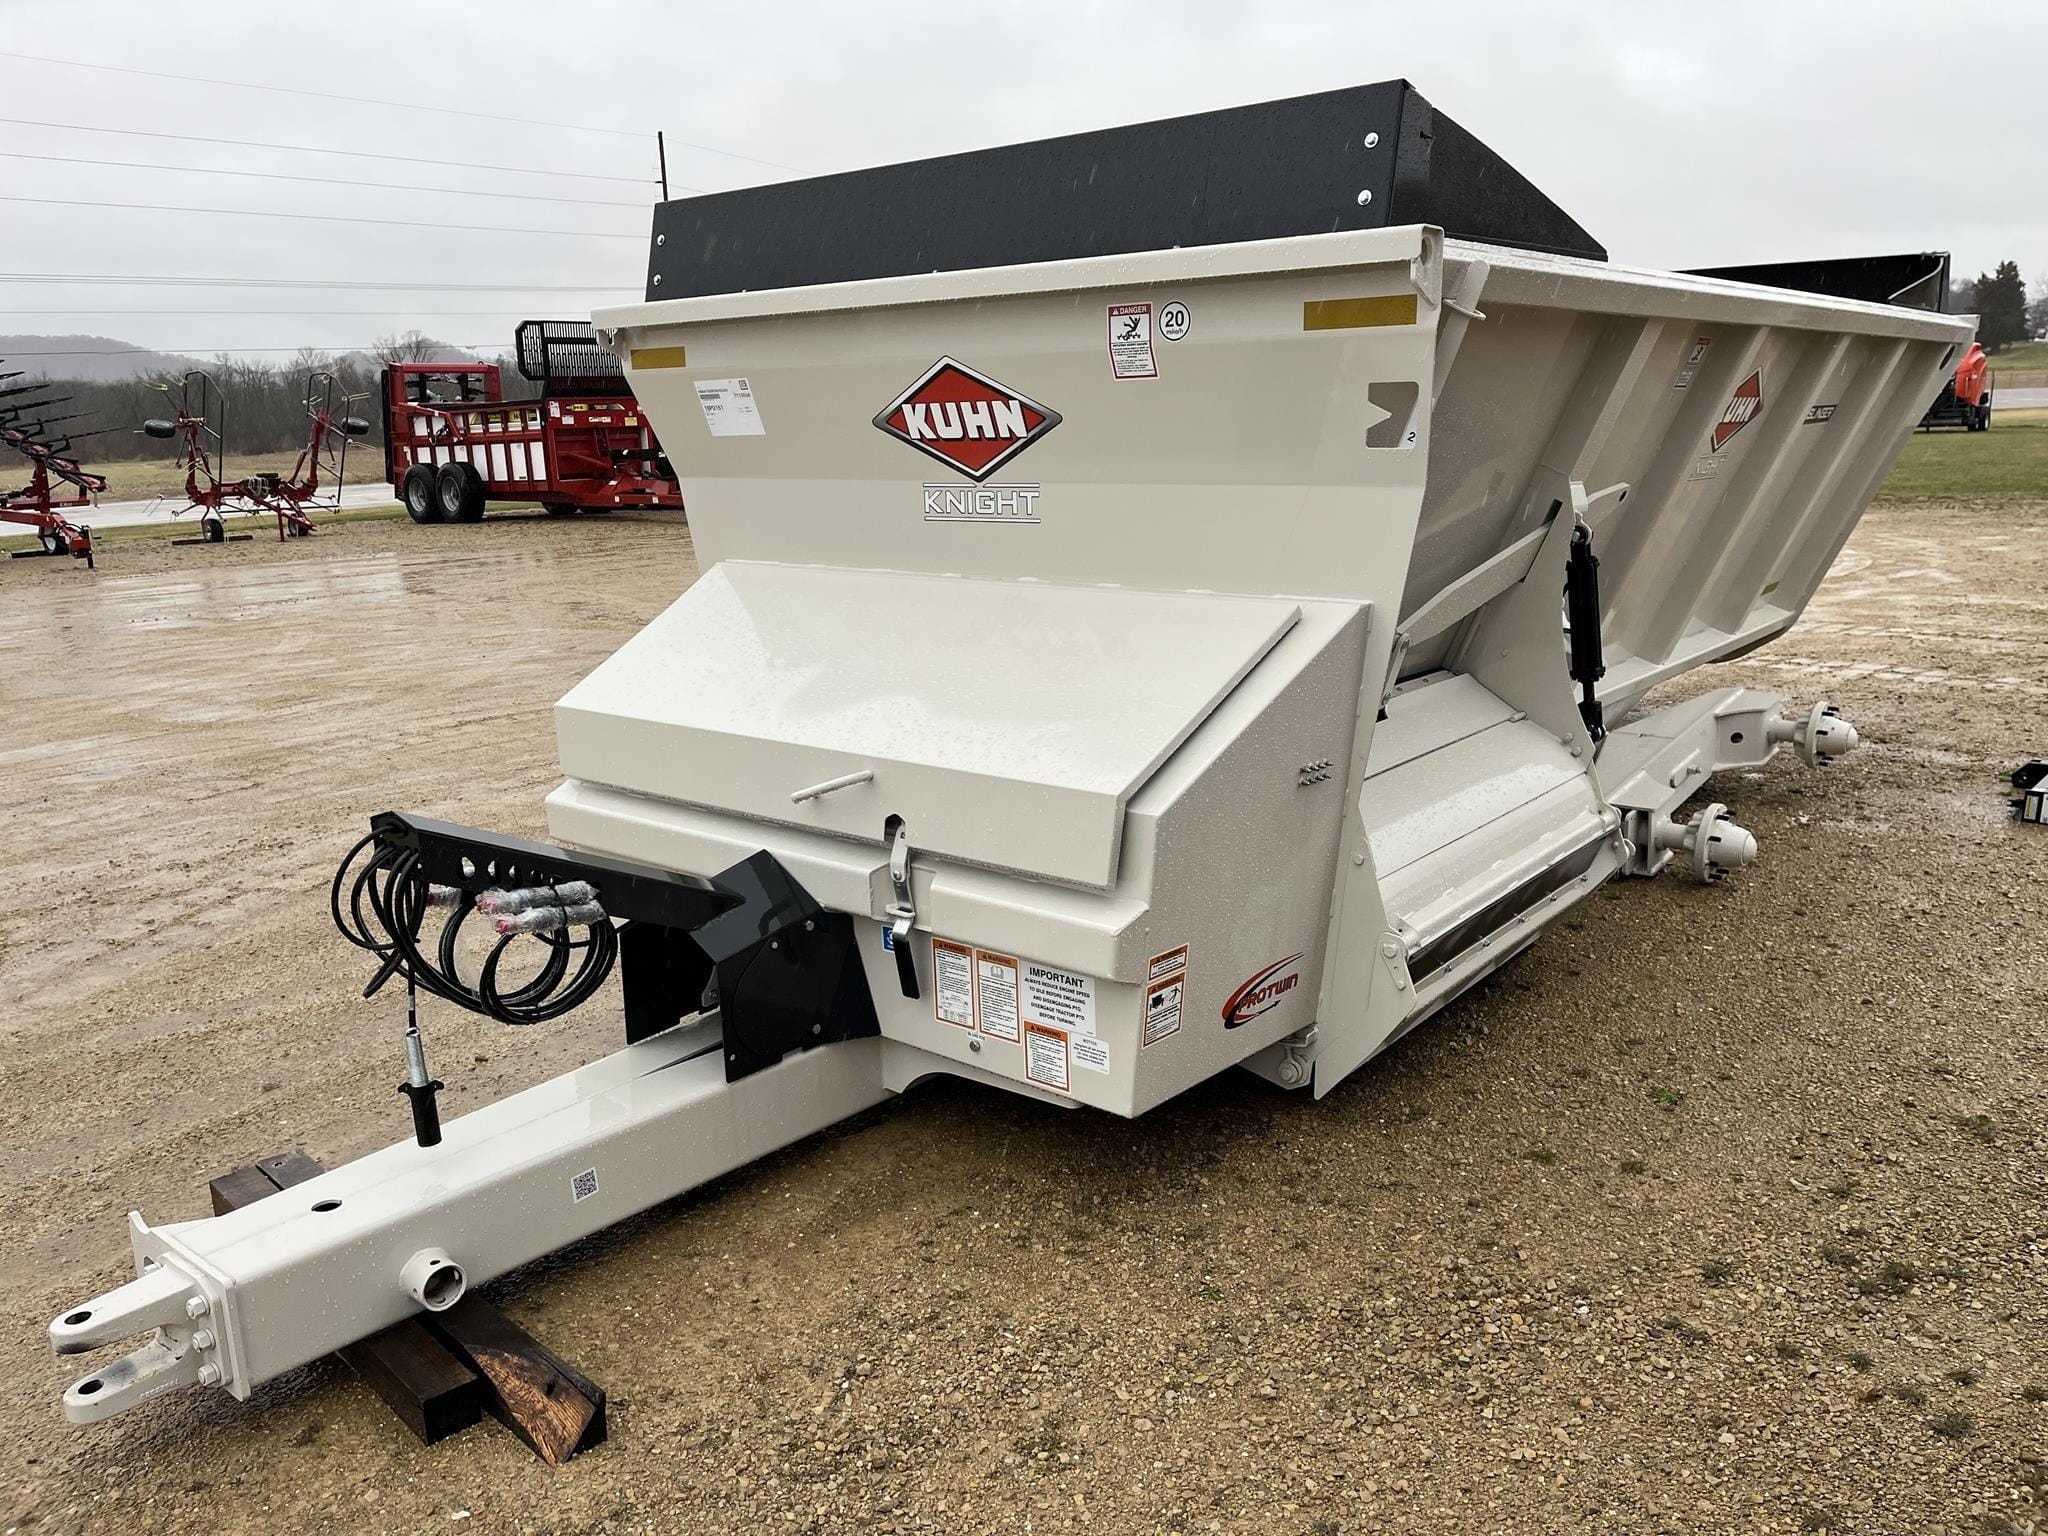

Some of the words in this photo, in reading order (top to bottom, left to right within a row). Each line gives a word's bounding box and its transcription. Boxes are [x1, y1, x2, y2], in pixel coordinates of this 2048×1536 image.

[1119, 306, 1147, 315] DANGER
[1165, 310, 1185, 328] 20
[1722, 396, 1760, 423] UHN
[901, 400, 1028, 440] KUHN
[923, 490, 1040, 515] KNIGHT
[1029, 966, 1084, 988] IMPORTANT
[1024, 976, 1041, 986] ALWAYS
[1041, 981, 1058, 990] REDUCE
[1059, 985, 1075, 995] ENGINE
[1076, 990, 1091, 999] SPEED
[1237, 973, 1299, 1013] PROTWIN
[1033, 994, 1042, 1002] AND
[1042, 996, 1071, 1010] DISENGAGING
[1046, 990, 1062, 999] BEFORE
[1063, 994, 1086, 1005] ENGAGING
[1030, 1001, 1055, 1012] DISENGAGE
[1055, 1008, 1076, 1018] TRACTOR
[1039, 1011, 1056, 1022] BEFORE
[1036, 1026, 1062, 1039] WARNING
